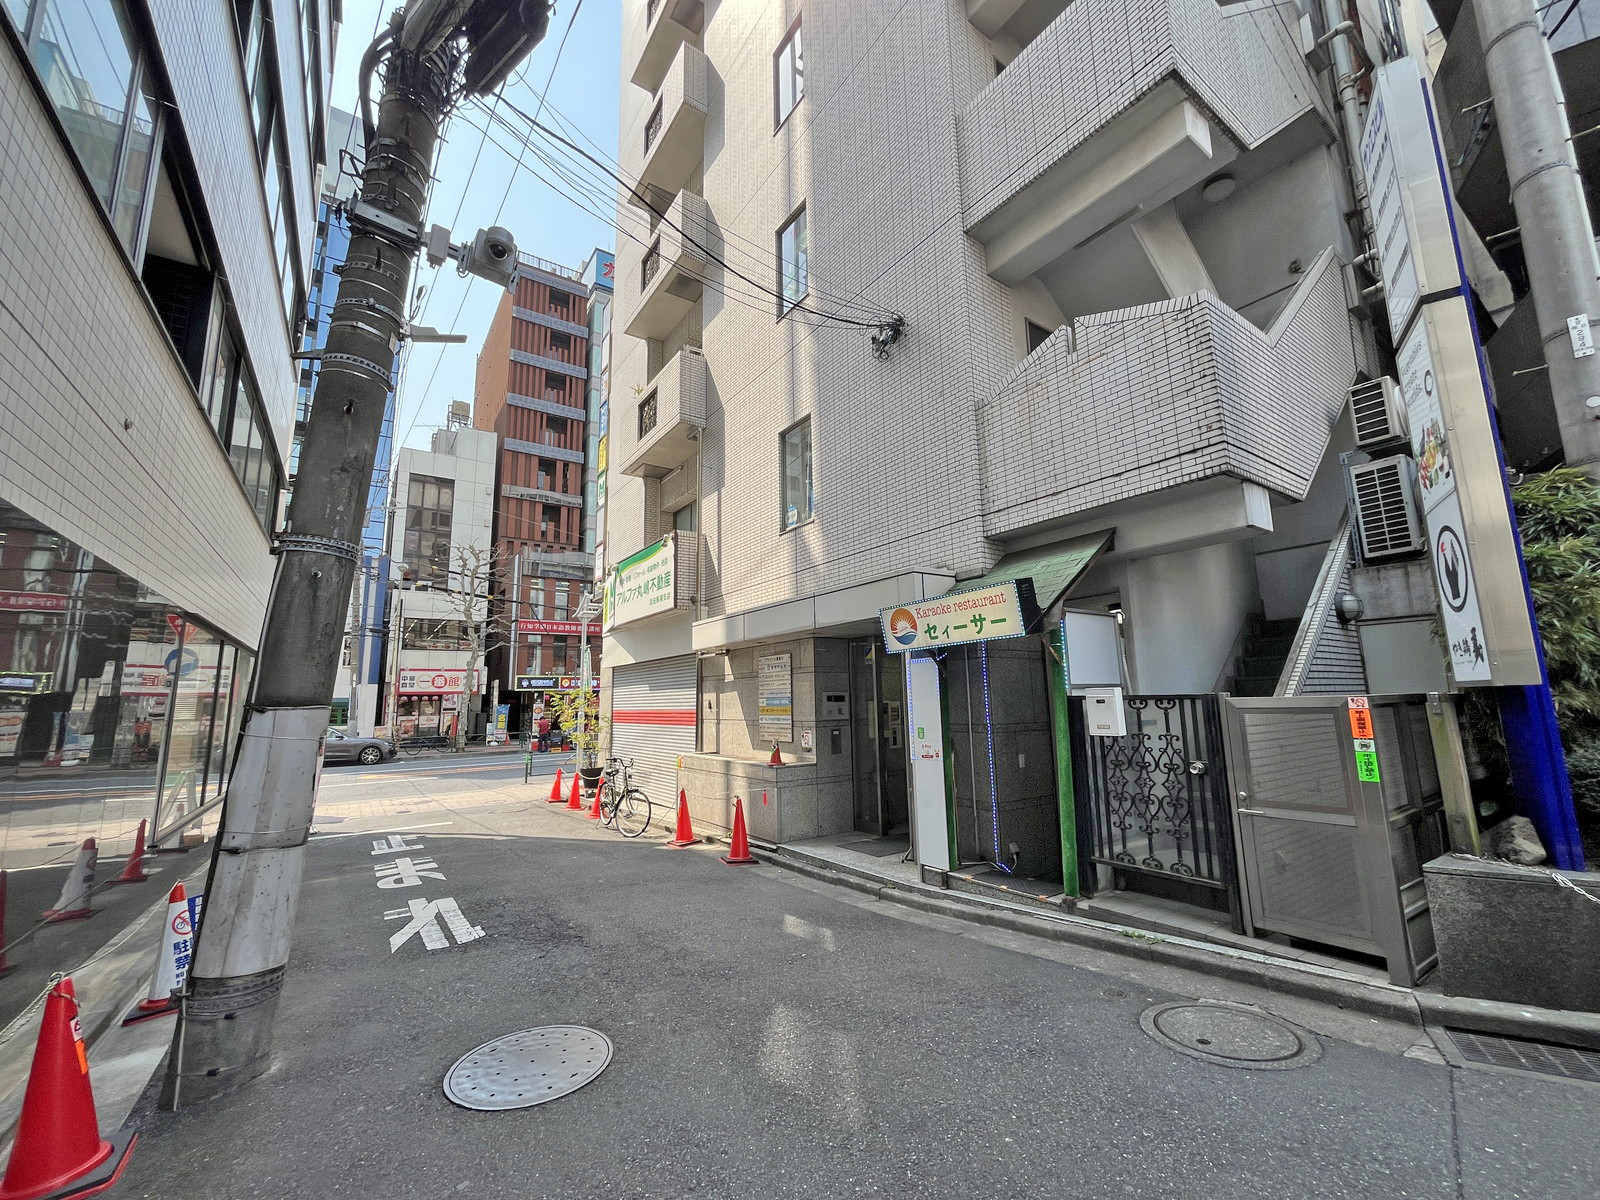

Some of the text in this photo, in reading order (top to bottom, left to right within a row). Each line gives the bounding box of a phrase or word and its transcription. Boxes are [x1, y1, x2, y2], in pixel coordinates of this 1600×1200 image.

[914, 591, 1007, 619] Karaoke restaurant
[924, 613, 1007, 640] セィーサー
[371, 834, 487, 954] 止まれ
